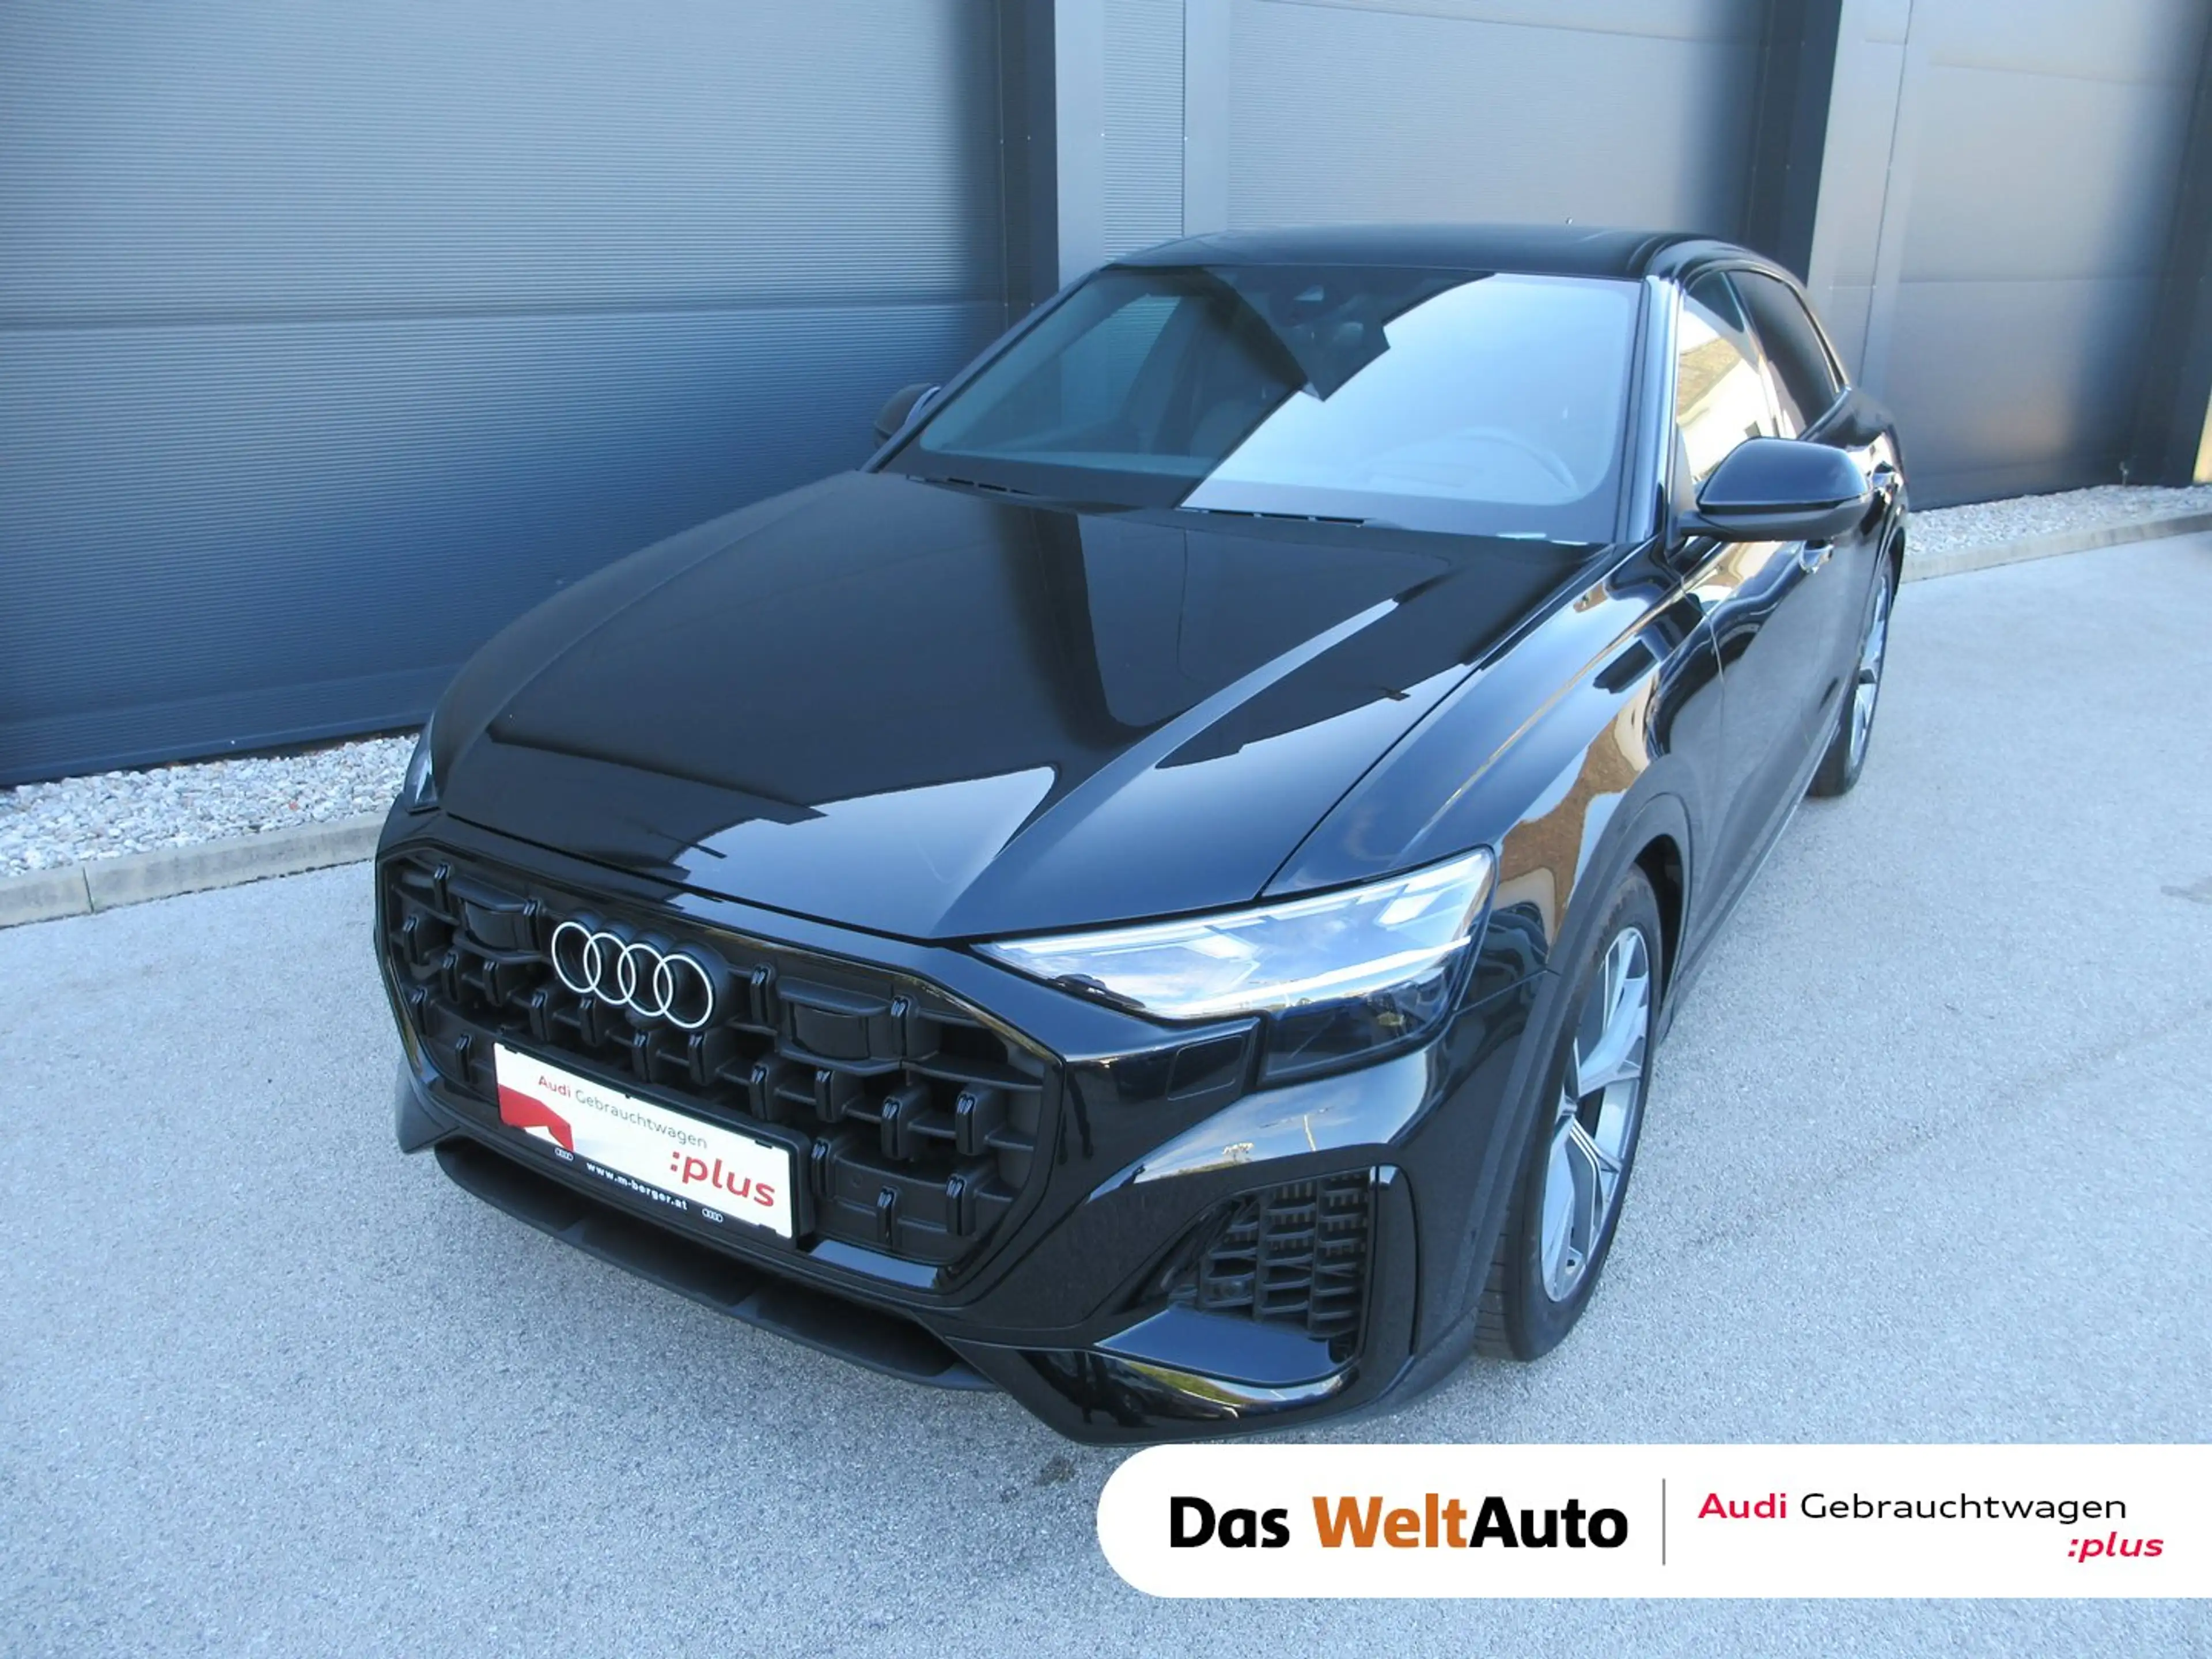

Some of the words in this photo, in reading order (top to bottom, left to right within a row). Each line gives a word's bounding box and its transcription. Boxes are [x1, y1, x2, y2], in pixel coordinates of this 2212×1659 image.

[538, 1075, 571, 1098] Audi
[575, 1090, 707, 1149] Gebrauchtwagen
[586, 1162, 688, 1211] www.m-berger.at
[670, 1151, 776, 1207] :plus
